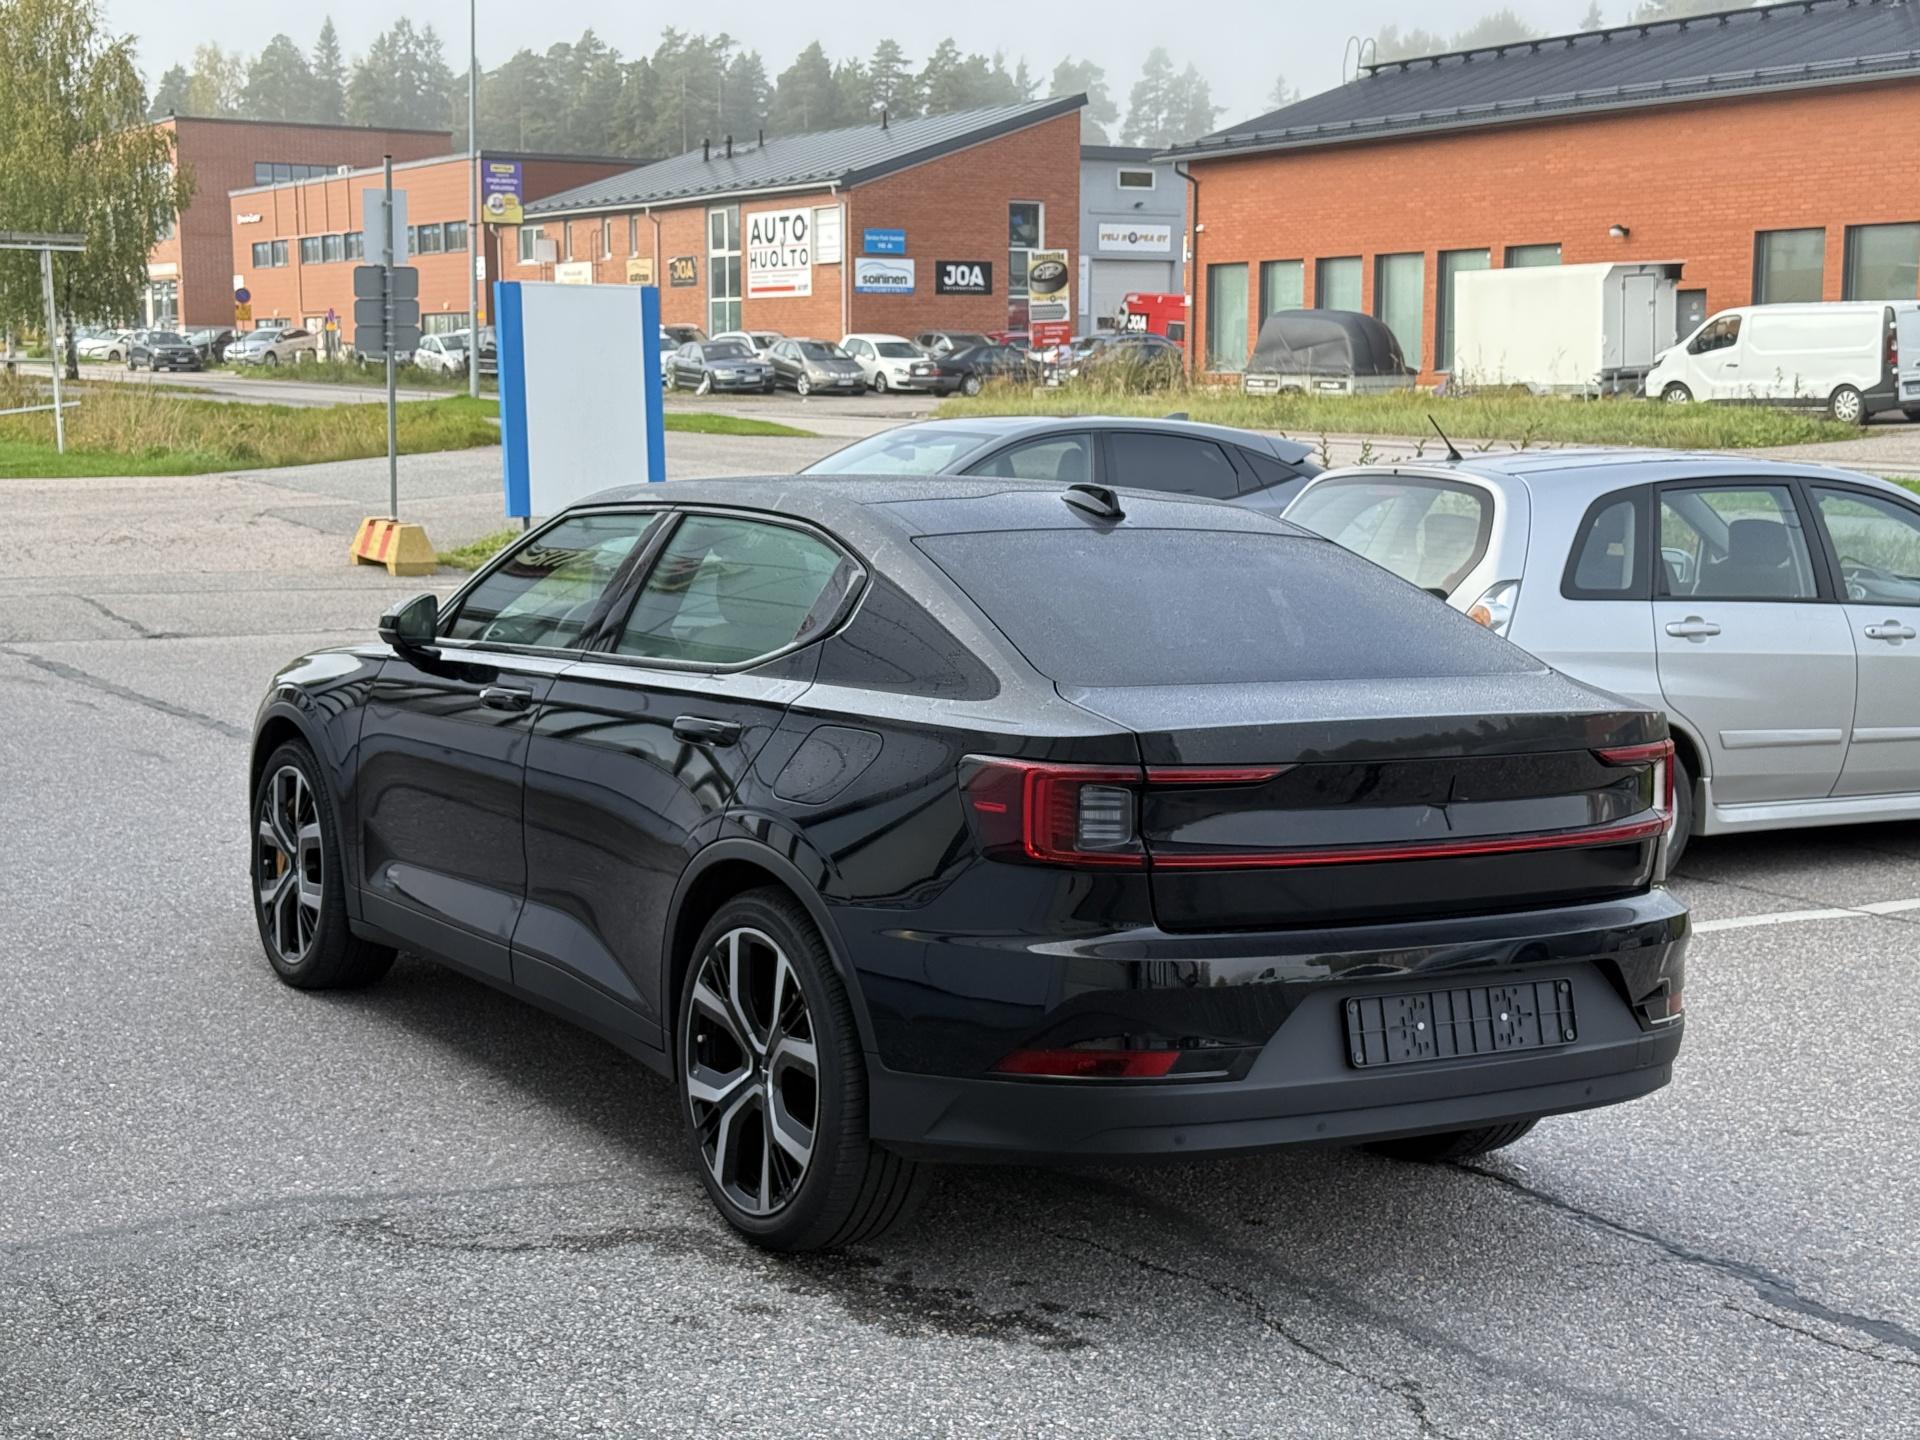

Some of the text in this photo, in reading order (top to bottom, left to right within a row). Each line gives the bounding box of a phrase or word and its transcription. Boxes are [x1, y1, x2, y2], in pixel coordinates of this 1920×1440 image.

[750, 214, 805, 245] AUTO
[750, 247, 808, 269] HUOLTO
[672, 260, 695, 279] JOA
[943, 264, 985, 287] JOA
[1127, 314, 1147, 331] JOA
